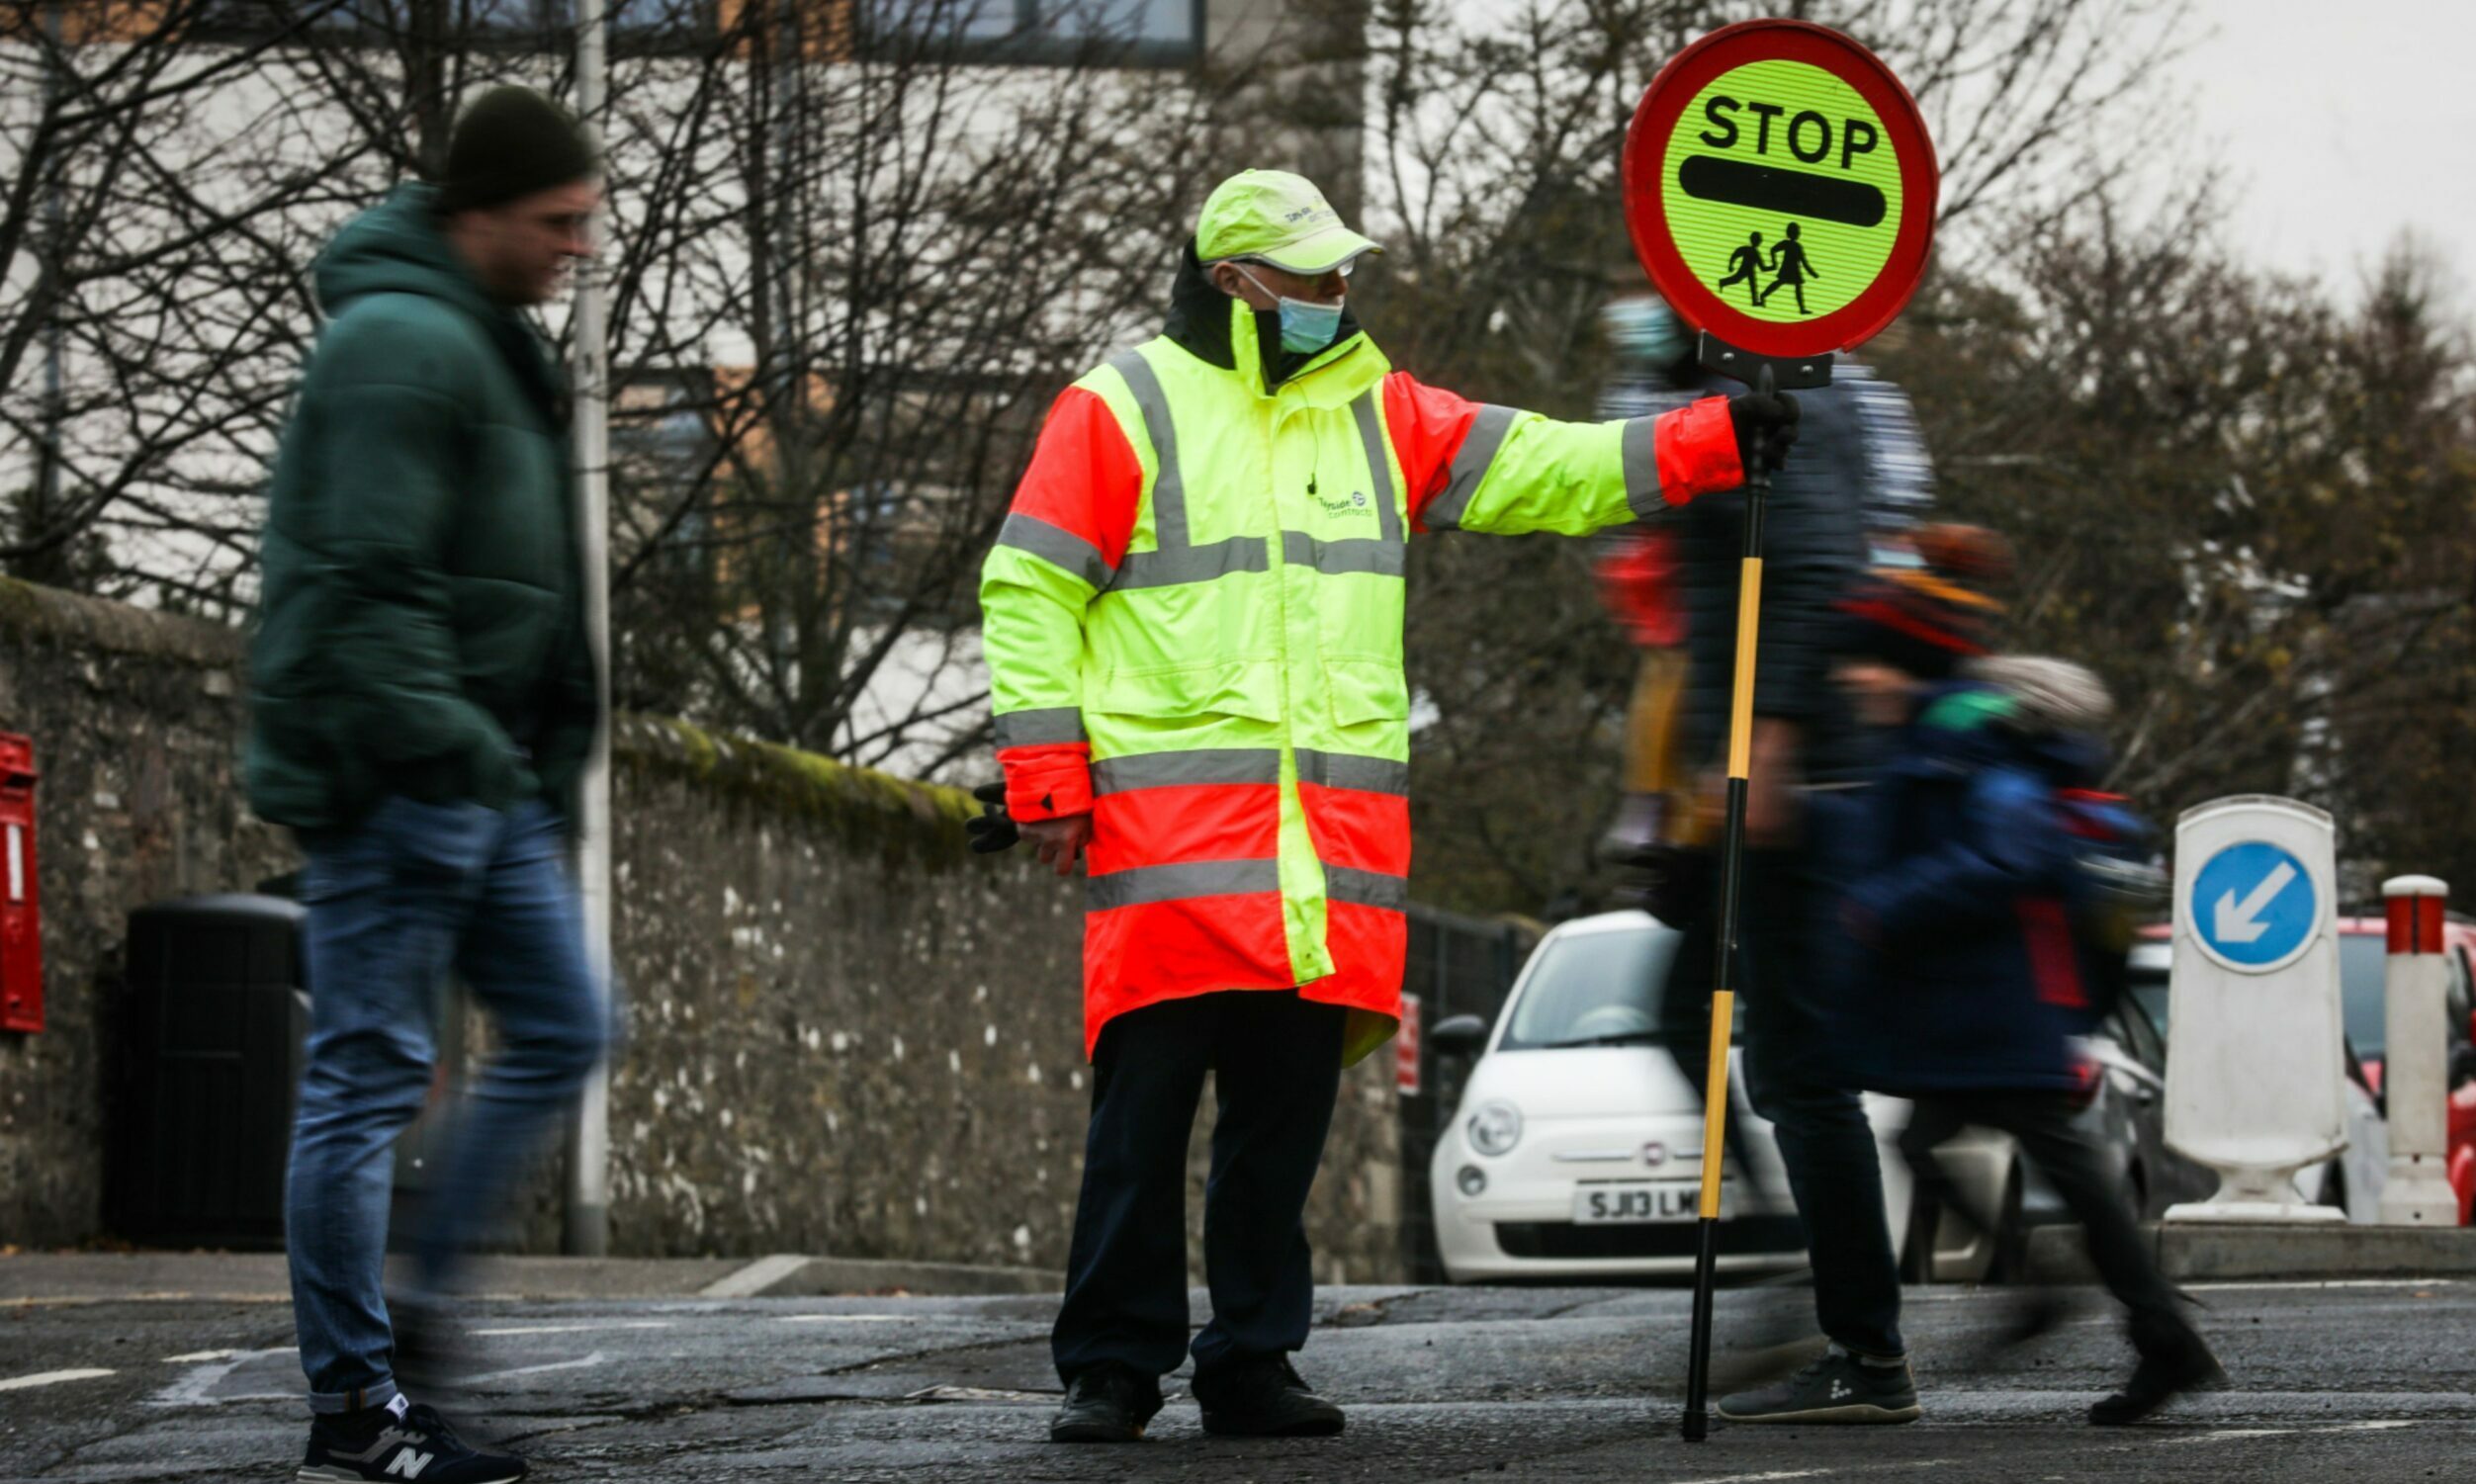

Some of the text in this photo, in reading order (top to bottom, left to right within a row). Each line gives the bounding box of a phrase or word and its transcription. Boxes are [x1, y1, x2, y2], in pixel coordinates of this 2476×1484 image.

[1698, 94, 1879, 169] STOP
[1589, 1188, 1701, 1218] SJ13 LM
[384, 1446, 435, 1480] N
